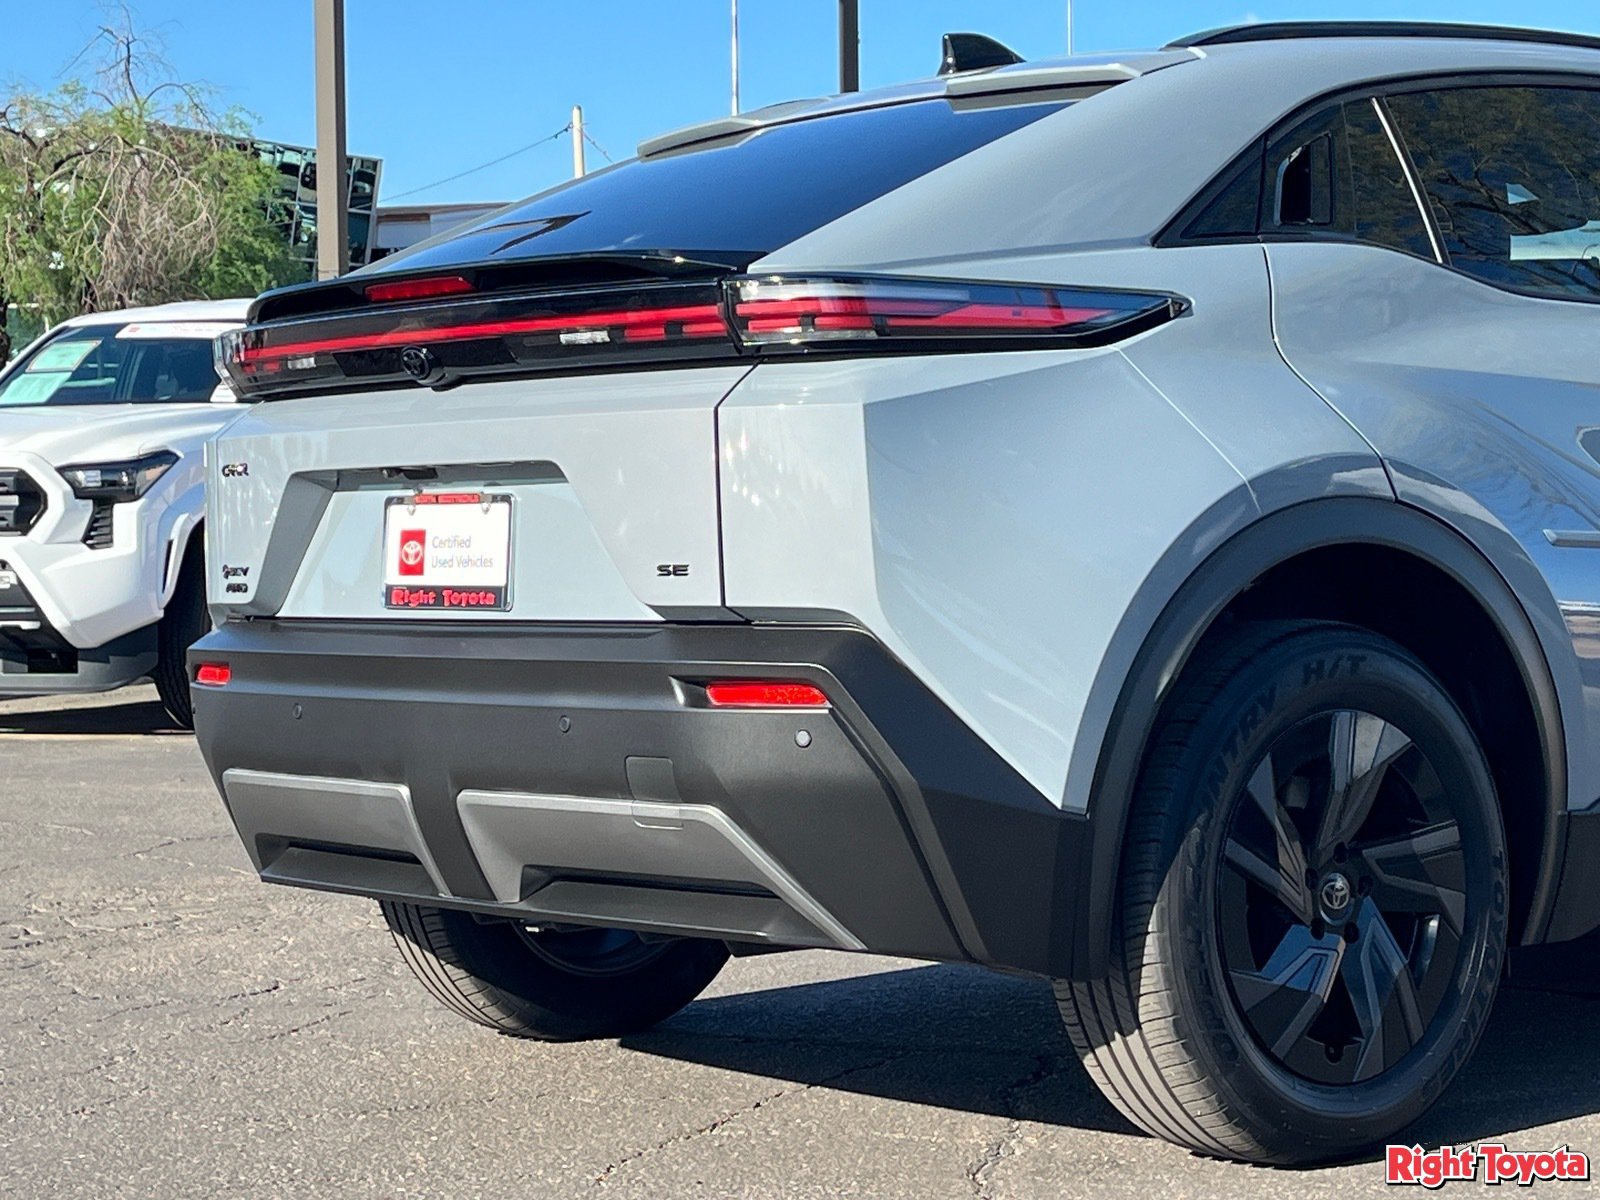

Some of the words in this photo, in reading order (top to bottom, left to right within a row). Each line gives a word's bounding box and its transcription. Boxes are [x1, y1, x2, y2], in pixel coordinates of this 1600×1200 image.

[431, 535, 472, 549] Certified
[431, 556, 454, 568] Used
[456, 555, 494, 568] Vehicles
[656, 564, 690, 577] SE
[391, 586, 437, 608] Right
[441, 588, 496, 608] Toyota
[1302, 654, 1368, 685] H/T
